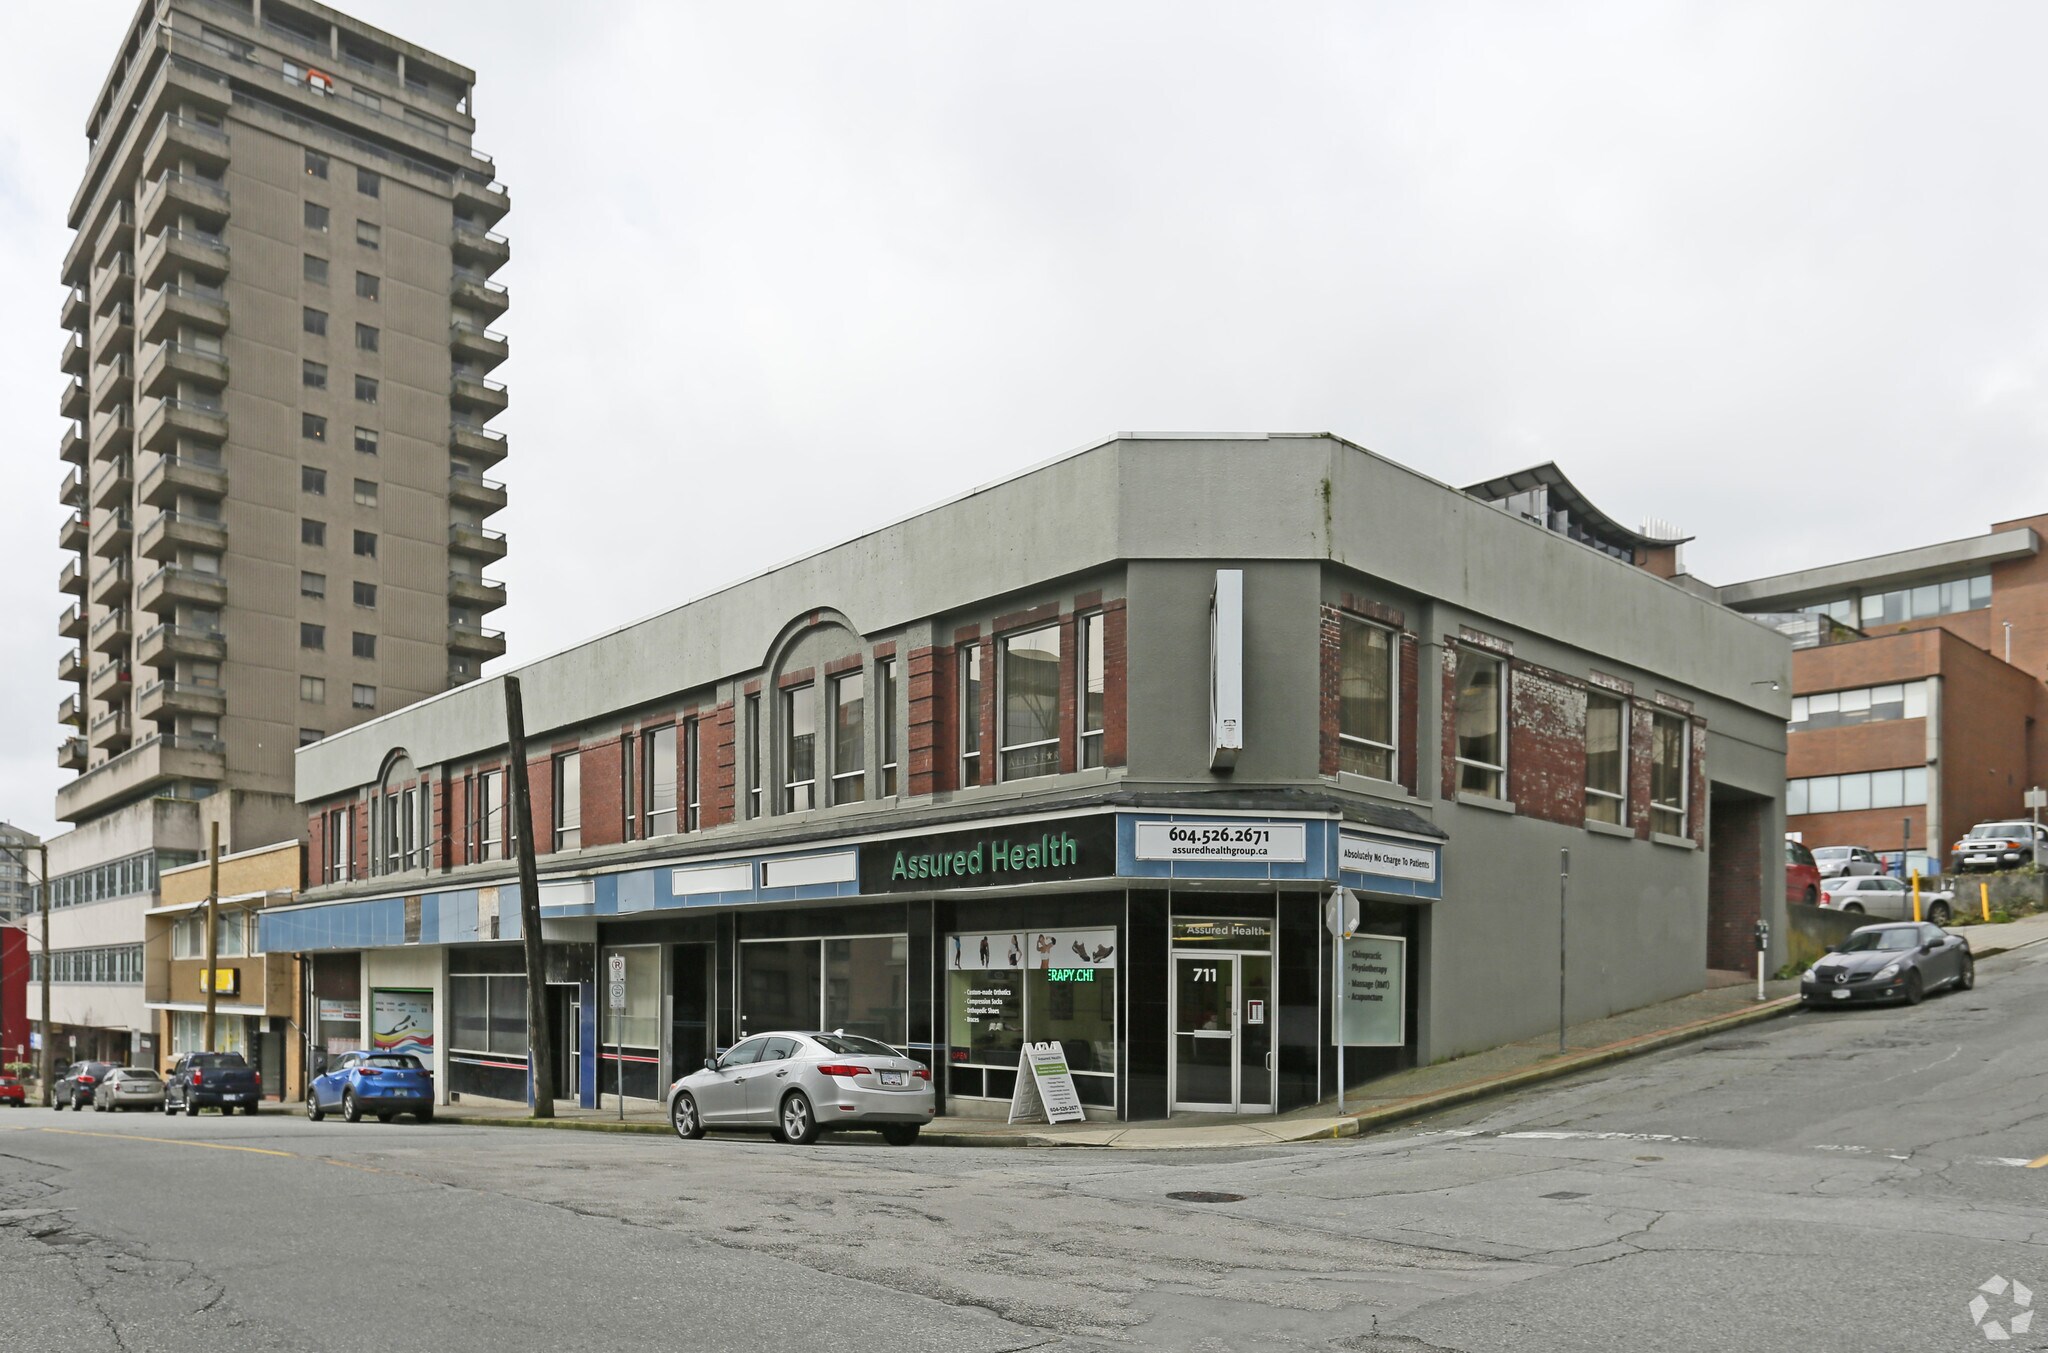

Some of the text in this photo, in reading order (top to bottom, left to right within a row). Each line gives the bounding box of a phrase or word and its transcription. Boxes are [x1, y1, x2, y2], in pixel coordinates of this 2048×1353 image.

[1169, 826, 1269, 845] 604.526.2671
[891, 831, 1077, 880] Assured Health
[1172, 846, 1268, 856] assuredhealthgroup.ca
[1344, 849, 1430, 869] Absolutely No Charge To Patients
[1186, 926, 1265, 936] Assured Health
[1351, 950, 1382, 960] Chiropractic
[1351, 963, 1388, 975] Physiotherapy
[1193, 968, 1217, 982] 711
[1351, 980, 1373, 990] Massage
[966, 998, 991, 1006] Compression
[1351, 992, 1383, 1003] Acupuncture
[952, 1052, 968, 1060] OPEN
